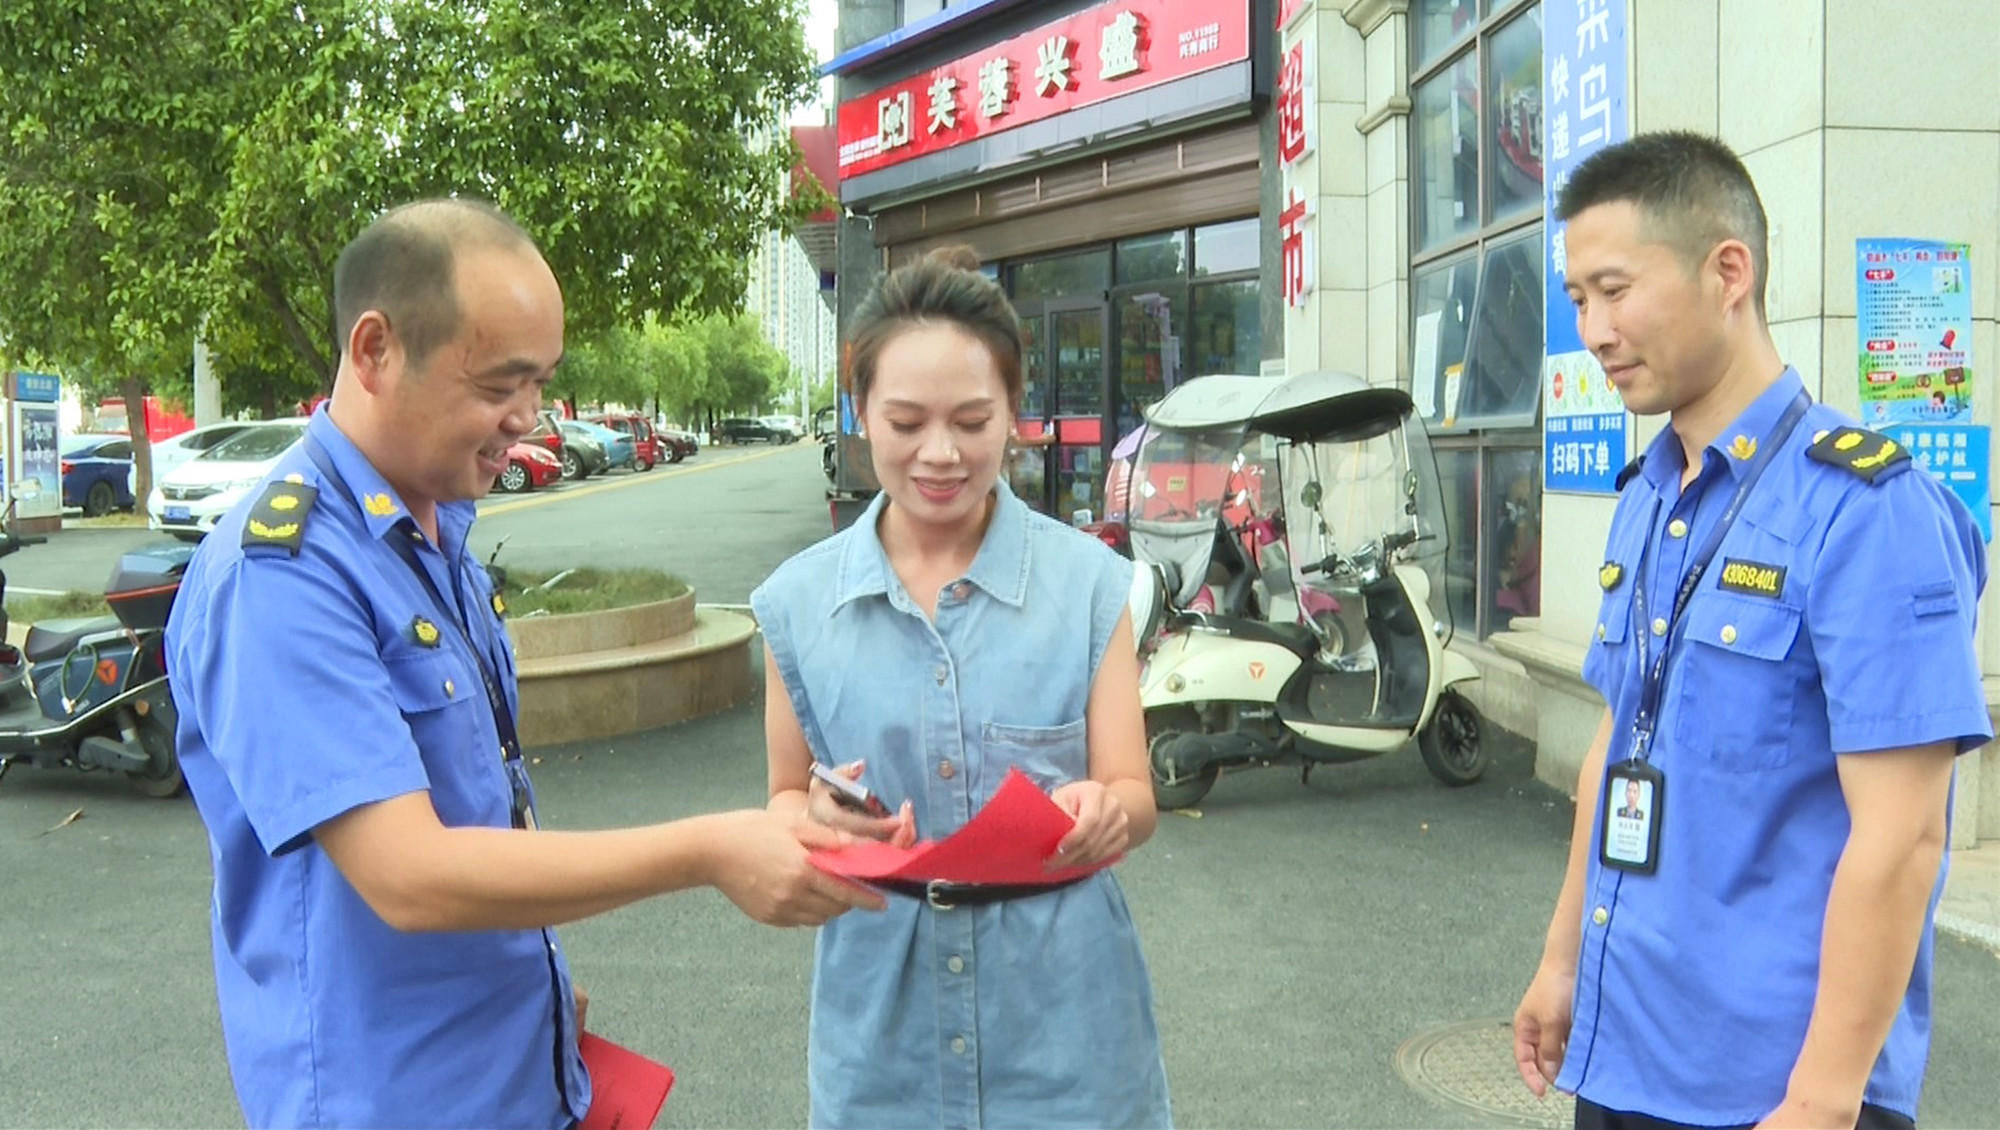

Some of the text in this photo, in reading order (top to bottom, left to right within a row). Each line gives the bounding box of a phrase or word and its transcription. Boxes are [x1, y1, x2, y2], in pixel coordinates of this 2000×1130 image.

[927, 9, 1139, 135] 芙蓉兴盛
[1275, 0, 1306, 307] 超市
[1552, 440, 1610, 476] 扫码下单
